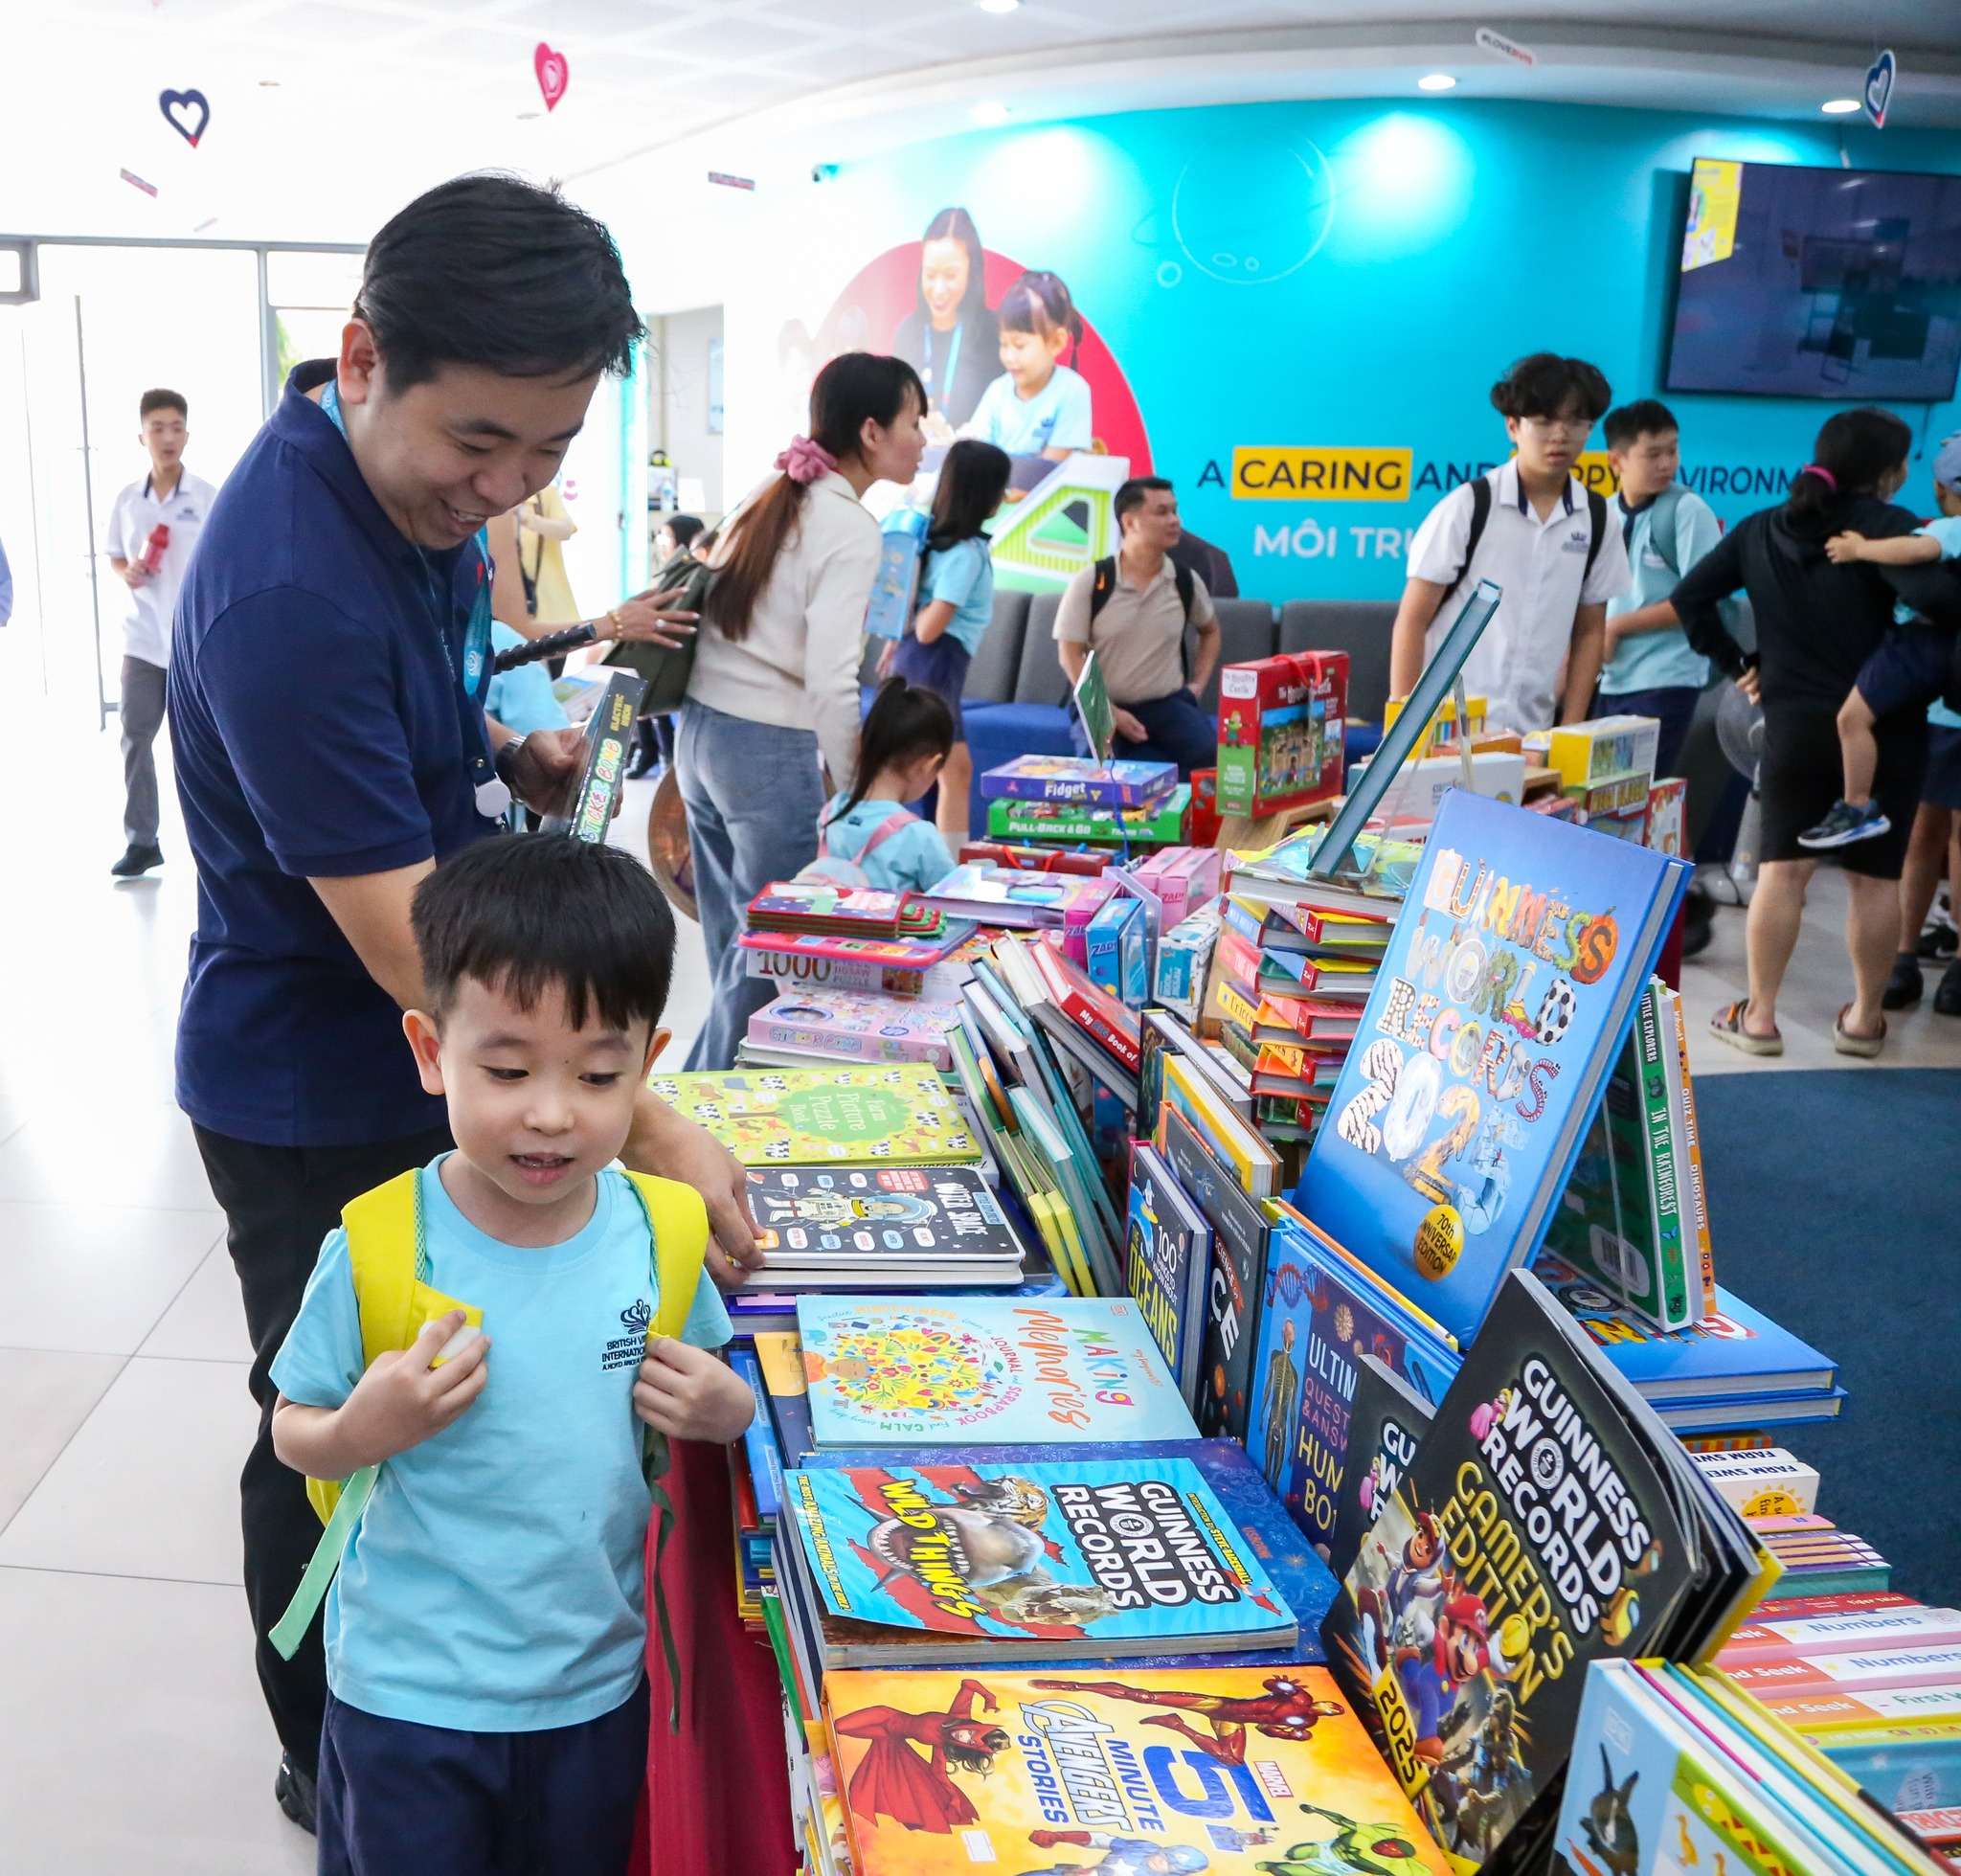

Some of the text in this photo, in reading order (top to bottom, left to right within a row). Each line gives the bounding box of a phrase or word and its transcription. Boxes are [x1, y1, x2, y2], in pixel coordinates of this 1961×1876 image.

[1197, 460, 1226, 488] A
[1239, 460, 1403, 491] CARING
[1252, 518, 1338, 558] MÔI
[1045, 781, 1086, 799] Fidget
[756, 950, 831, 983] 1000
[1079, 1008, 1138, 1062] My Book of
[1376, 977, 1562, 1124] RECORDS
[1643, 1020, 1658, 1063] EXPLORERS
[808, 1096, 841, 1131] Puzzle
[836, 1093, 867, 1131] Picture
[1681, 1088, 1697, 1147] QUIZ TIME
[1651, 1107, 1678, 1216] IN THE RAINFOREST
[934, 1182, 989, 1236] OUTER SPACE
[1690, 1164, 1706, 1232] DINOSAURS
[1157, 1225, 1177, 1274] 100
[1436, 1213, 1455, 1240] 70th
[1128, 1242, 1178, 1367] OCEANS
[606, 1338, 637, 1351] BRITISH
[991, 1335, 1026, 1374] JOURNAL
[879, 1422, 925, 1433] CALM
[954, 1386, 1024, 1427] SCRAPBOOK
[1522, 1358, 1652, 1565] GUINNESS
[1730, 1450, 1777, 1462] FARM
[1751, 1464, 1799, 1476] FARM
[797, 1475, 810, 1487] THE
[800, 1486, 813, 1501] MOST
[1502, 1387, 1623, 1597] WORLD
[802, 1500, 826, 1538] AMAZING
[1304, 1478, 1338, 1539] BO
[1480, 1425, 1601, 1635] RECORDS
[814, 1537, 839, 1575] ANIMALS
[881, 1478, 989, 1619] WILD THINGS
[1057, 1485, 1144, 1608] RECORDS
[1095, 1484, 1186, 1604] WORLD
[1141, 1482, 1233, 1602] GUINNESS
[1209, 1528, 1232, 1550] STEVE
[1221, 1548, 1253, 1586] BACKSHALL
[1455, 1460, 1575, 1682] GAMER'S
[1808, 1614, 1924, 1634] Numbers
[1754, 1663, 1809, 1679] Seek
[1849, 1649, 1961, 1670] Numbers
[1799, 1700, 1857, 1716] Seek
[1892, 1691, 1949, 1706] First
[1379, 1681, 1423, 1784] 2025
[1017, 1734, 1069, 1824] STORIES
[1018, 1700, 1133, 1833] AVENGERS
[1105, 1738, 1166, 1834] MINUTE
[1253, 1761, 1295, 1798] MARVEL
